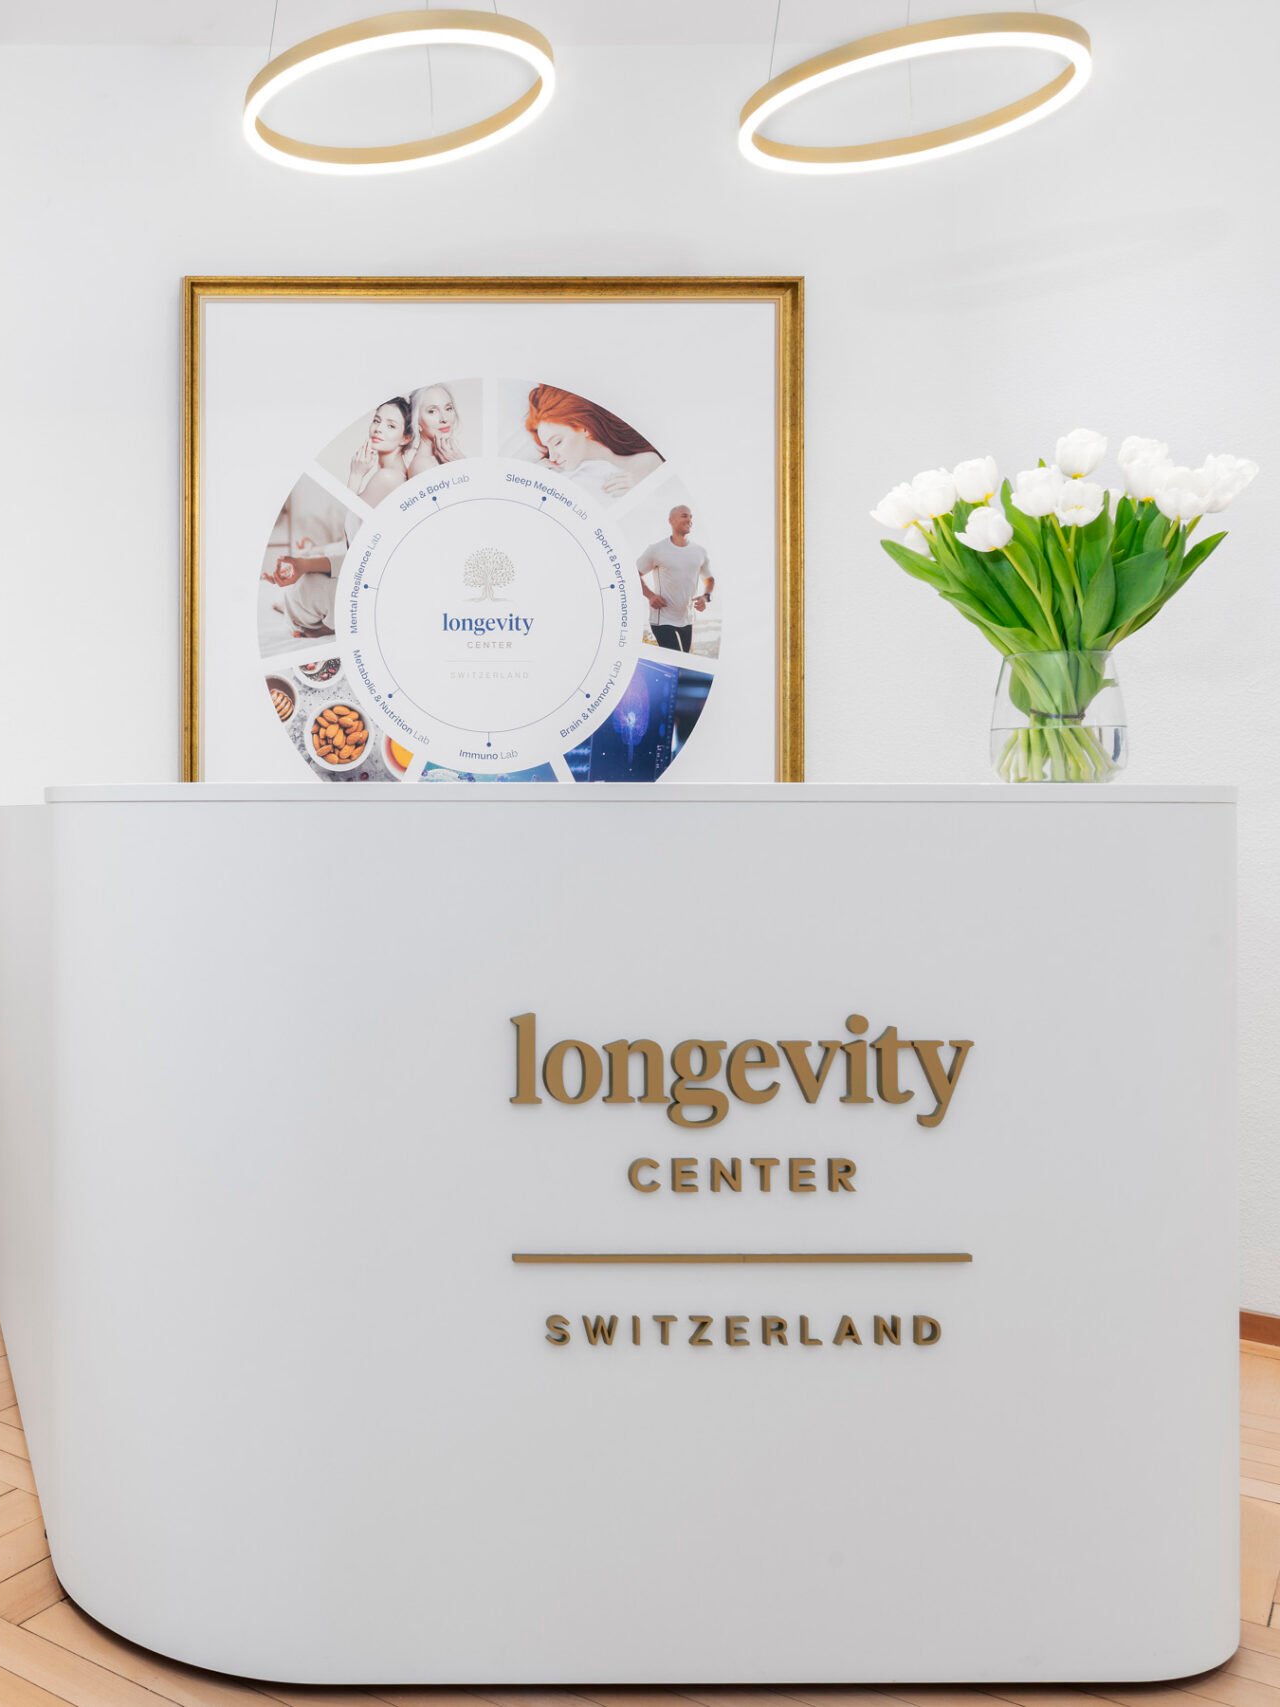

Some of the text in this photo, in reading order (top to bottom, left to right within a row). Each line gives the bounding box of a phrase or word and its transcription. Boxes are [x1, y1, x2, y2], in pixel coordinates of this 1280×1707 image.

[400, 475, 470, 512] Skin & Body Lab
[506, 474, 588, 520] Sleep Medicine Lab
[350, 533, 382, 634] Mental Resilience Lab
[594, 528, 628, 648] Sport & Performance Lab
[442, 613, 534, 636] longevity
[466, 641, 513, 649] CENTER
[449, 671, 530, 679] SWITZERLAND
[353, 649, 376, 695] Metabolic
[380, 701, 413, 734] Nutrition
[412, 731, 430, 745] Lab
[560, 660, 622, 738] Brain & Memory Lab
[459, 749, 518, 760] Immuno Lab
[509, 1012, 975, 1129] longevity
[628, 1156, 858, 1193] CENTER
[545, 1314, 943, 1347] SWITZERLAND
